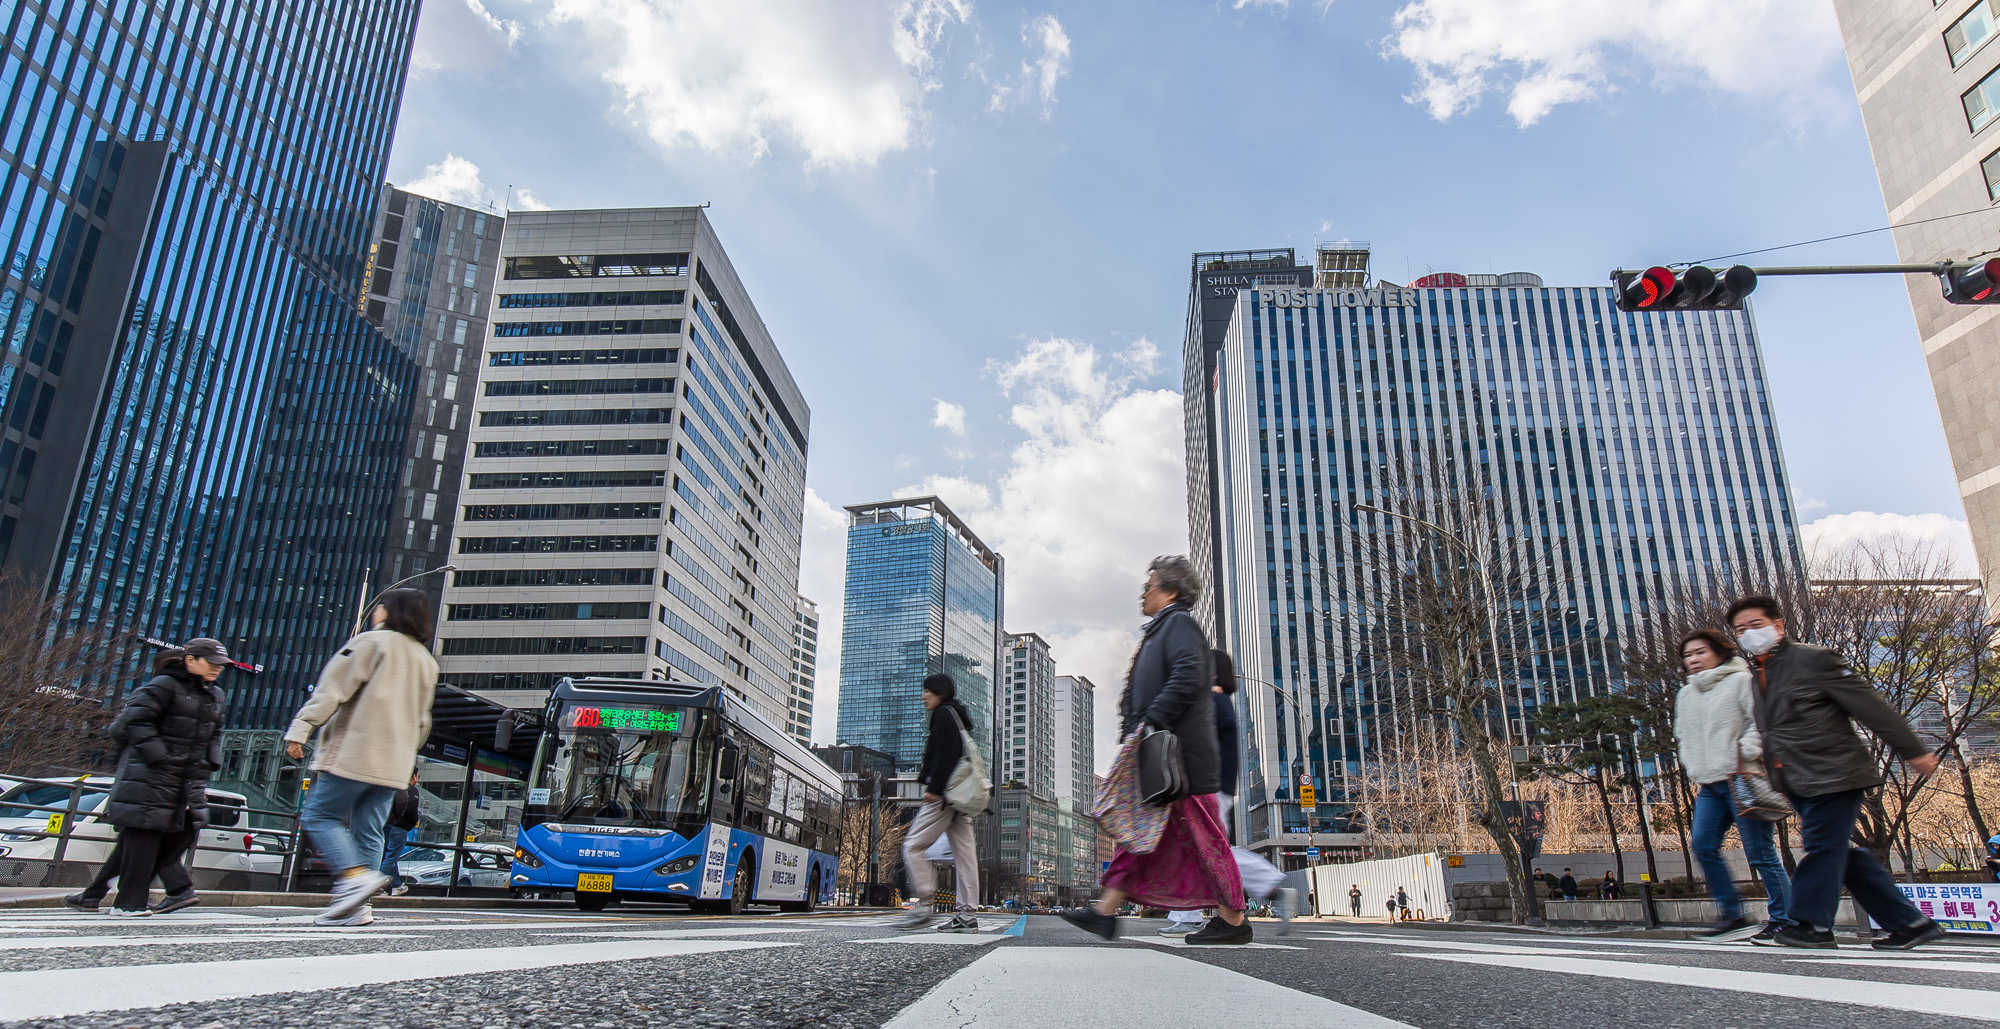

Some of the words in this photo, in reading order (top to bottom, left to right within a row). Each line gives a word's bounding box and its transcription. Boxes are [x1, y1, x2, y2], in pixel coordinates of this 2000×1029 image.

[1207, 276, 1249, 286] SHILLA
[1260, 288, 1321, 308] POST
[1327, 289, 1418, 308] TOWER
[892, 523, 930, 535] 경찰공제회
[572, 707, 601, 727] 260
[588, 826, 620, 834] HIGER
[578, 848, 596, 857] 친환경
[596, 849, 621, 858] 전기버스
[586, 881, 611, 890] 6888
[1899, 886, 1915, 899] 짐
[1916, 886, 1938, 899] 마포
[1940, 886, 1983, 899] 공덕역점
[1943, 901, 1977, 918] 혜택
[1952, 921, 1969, 930] 파격
